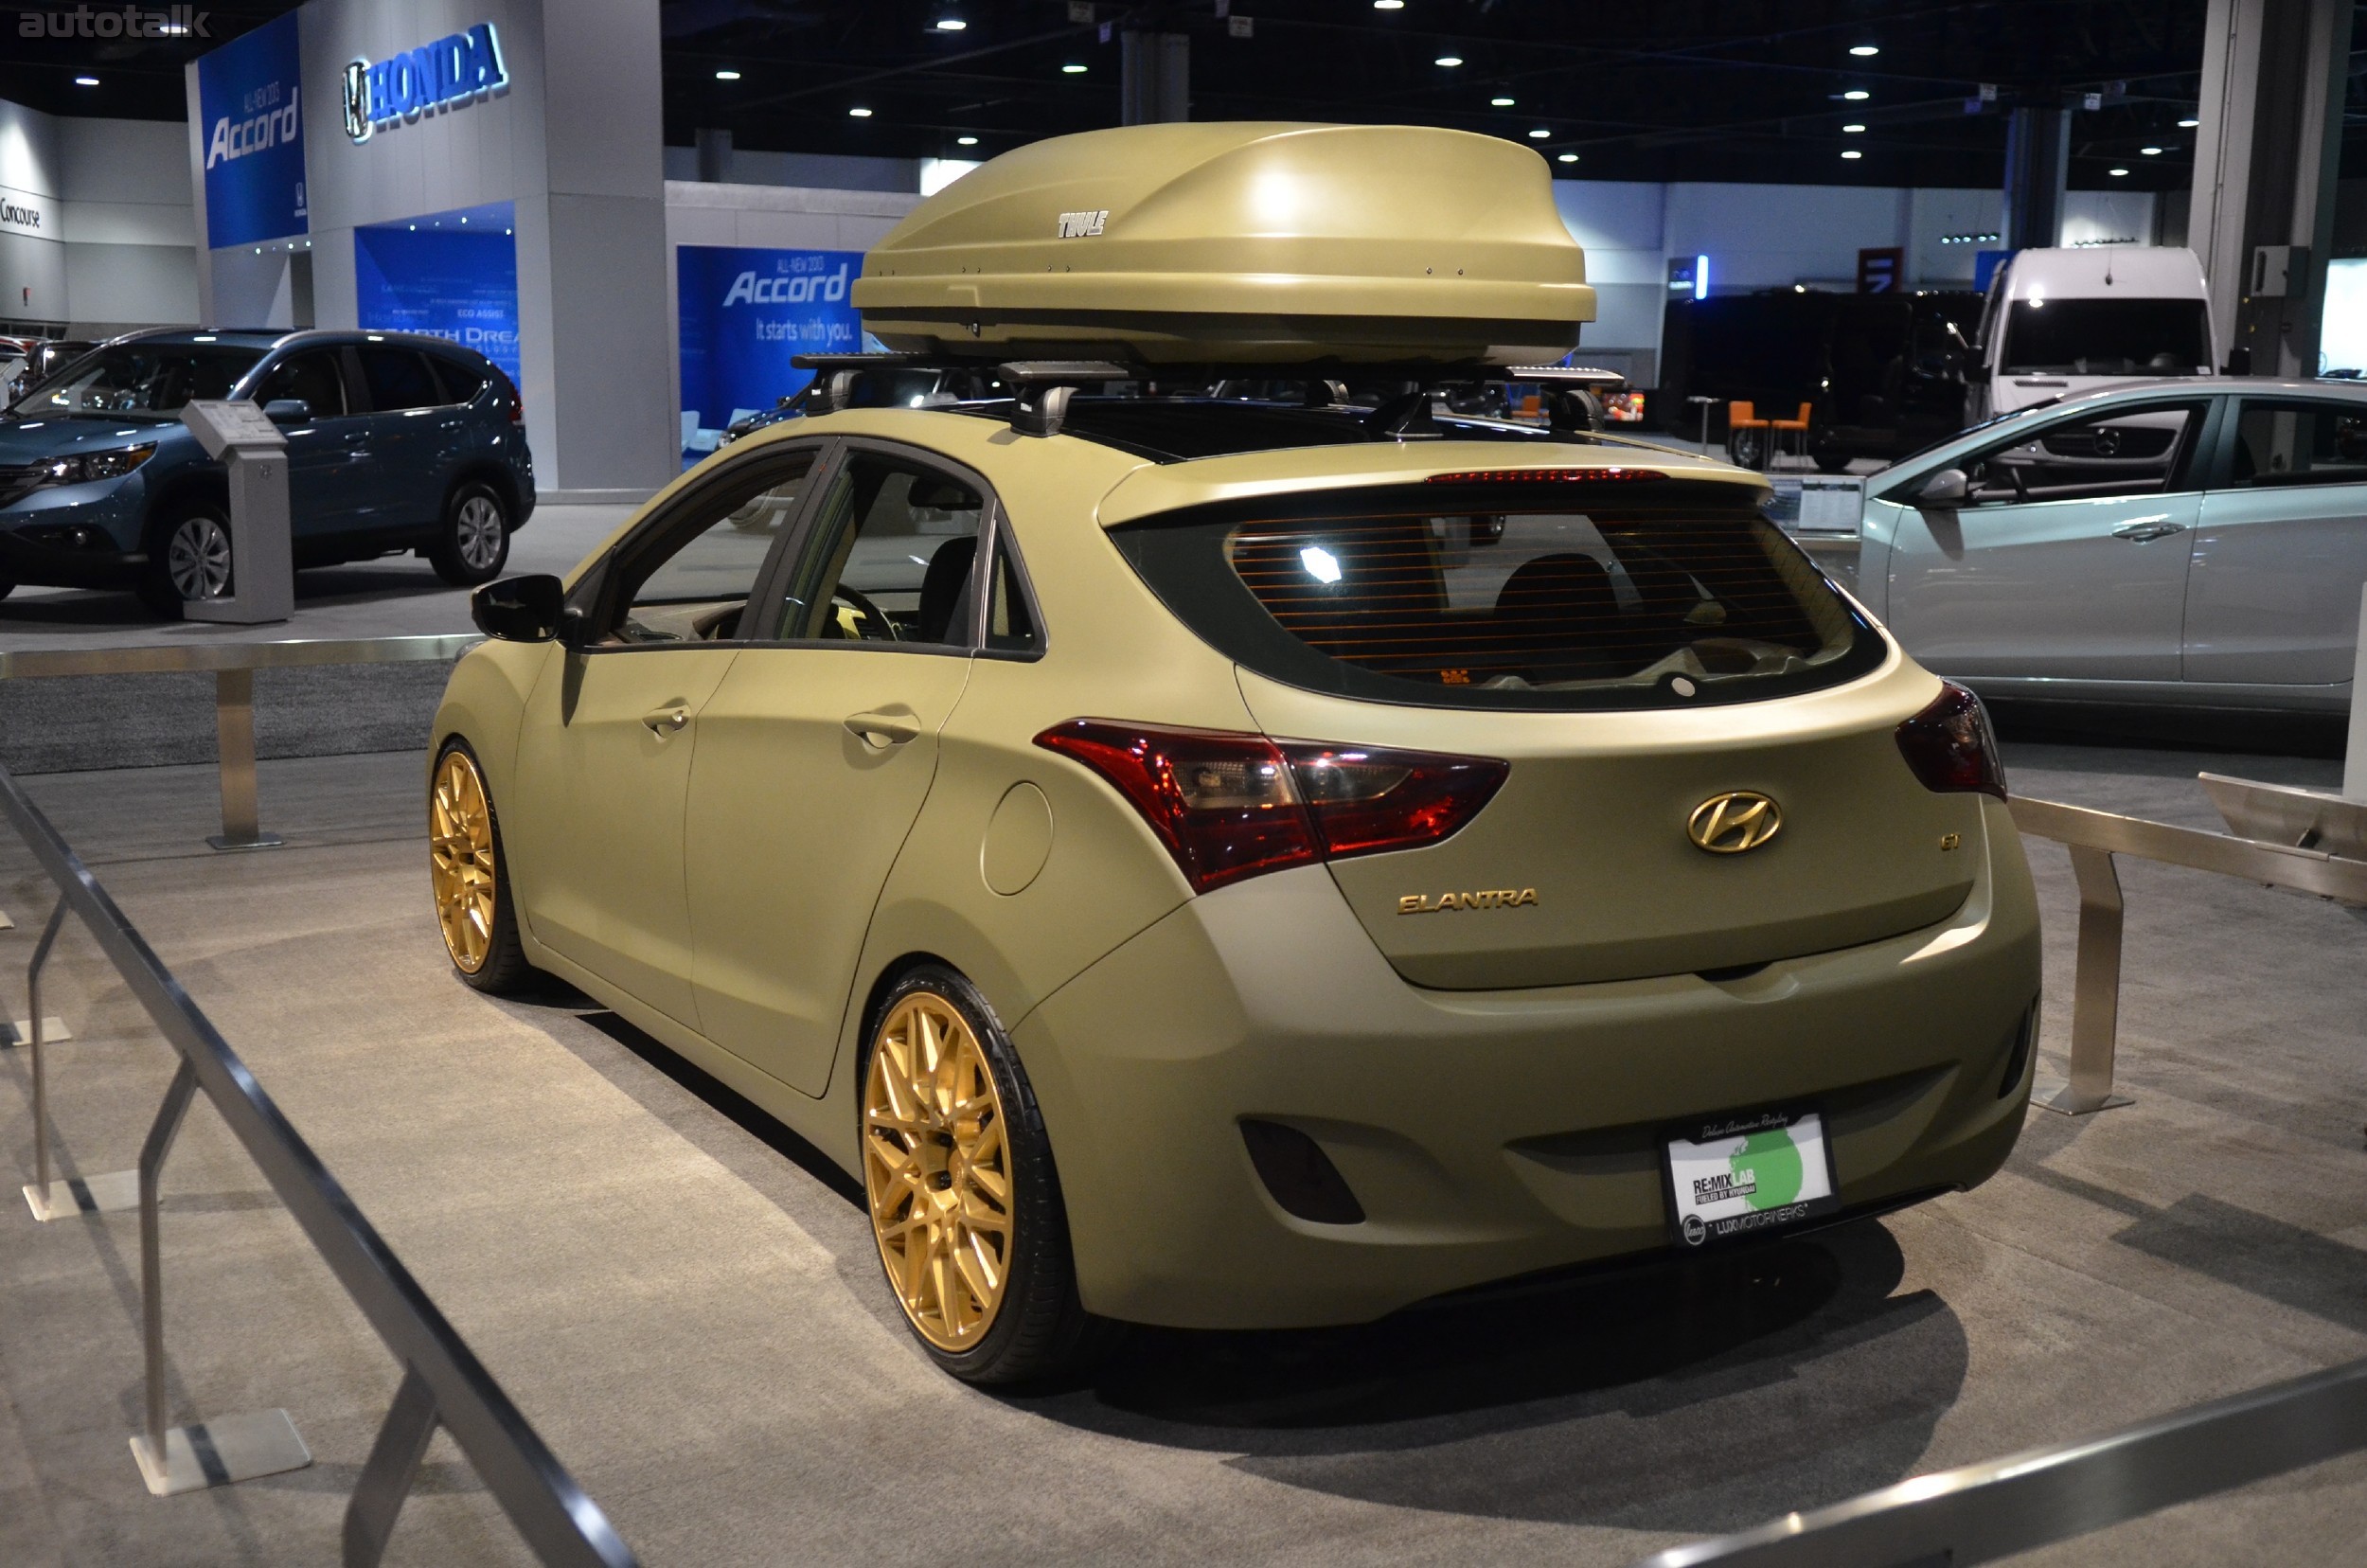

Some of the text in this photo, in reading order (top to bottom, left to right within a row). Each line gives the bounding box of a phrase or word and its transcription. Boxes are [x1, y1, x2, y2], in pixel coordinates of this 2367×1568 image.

[367, 23, 505, 122] HONDA
[206, 86, 298, 169] Accord
[0, 197, 40, 228] Concourse
[1059, 210, 1109, 238] THULE
[722, 262, 848, 307] Accord
[756, 317, 853, 347] It starts with you.
[1397, 888, 1539, 915] ELANTRA
[1696, 1185, 1755, 1204] FUELED BY HYUNDAI
